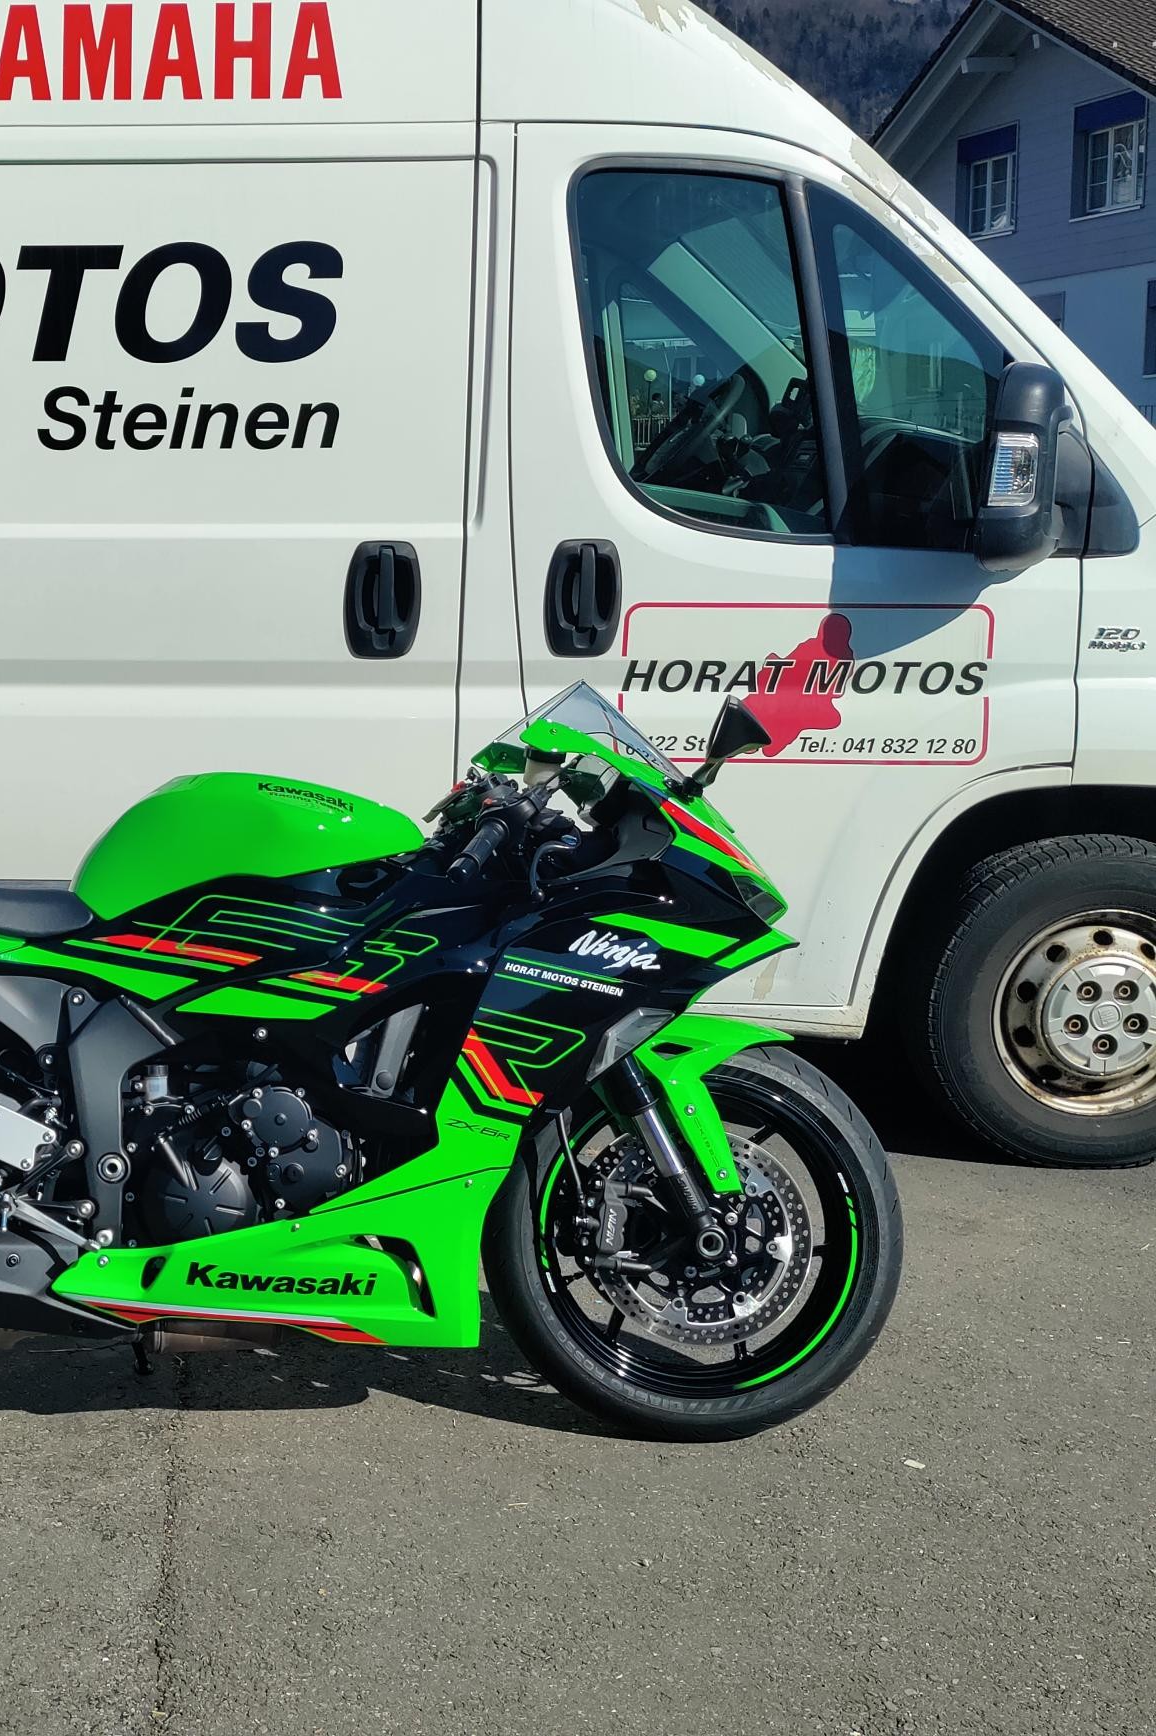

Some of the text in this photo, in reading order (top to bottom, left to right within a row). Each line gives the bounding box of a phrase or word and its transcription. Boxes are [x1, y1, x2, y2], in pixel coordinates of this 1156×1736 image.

[38, 386, 341, 452] Steinen
[1093, 627, 1141, 640] 120
[621, 659, 989, 697] HORAT MOTOS
[799, 736, 978, 755] Tel.: 041 832 12 80
[257, 782, 355, 813] Kawasaki
[568, 929, 662, 971] Ninja
[504, 962, 624, 997] HORAT MOTOS STEINEN
[444, 1118, 511, 1142] ZX-6R
[185, 1261, 379, 1297] Kawasaki
[556, 1330, 606, 1380] ROSSO
[610, 1376, 685, 1412] DIABLO
